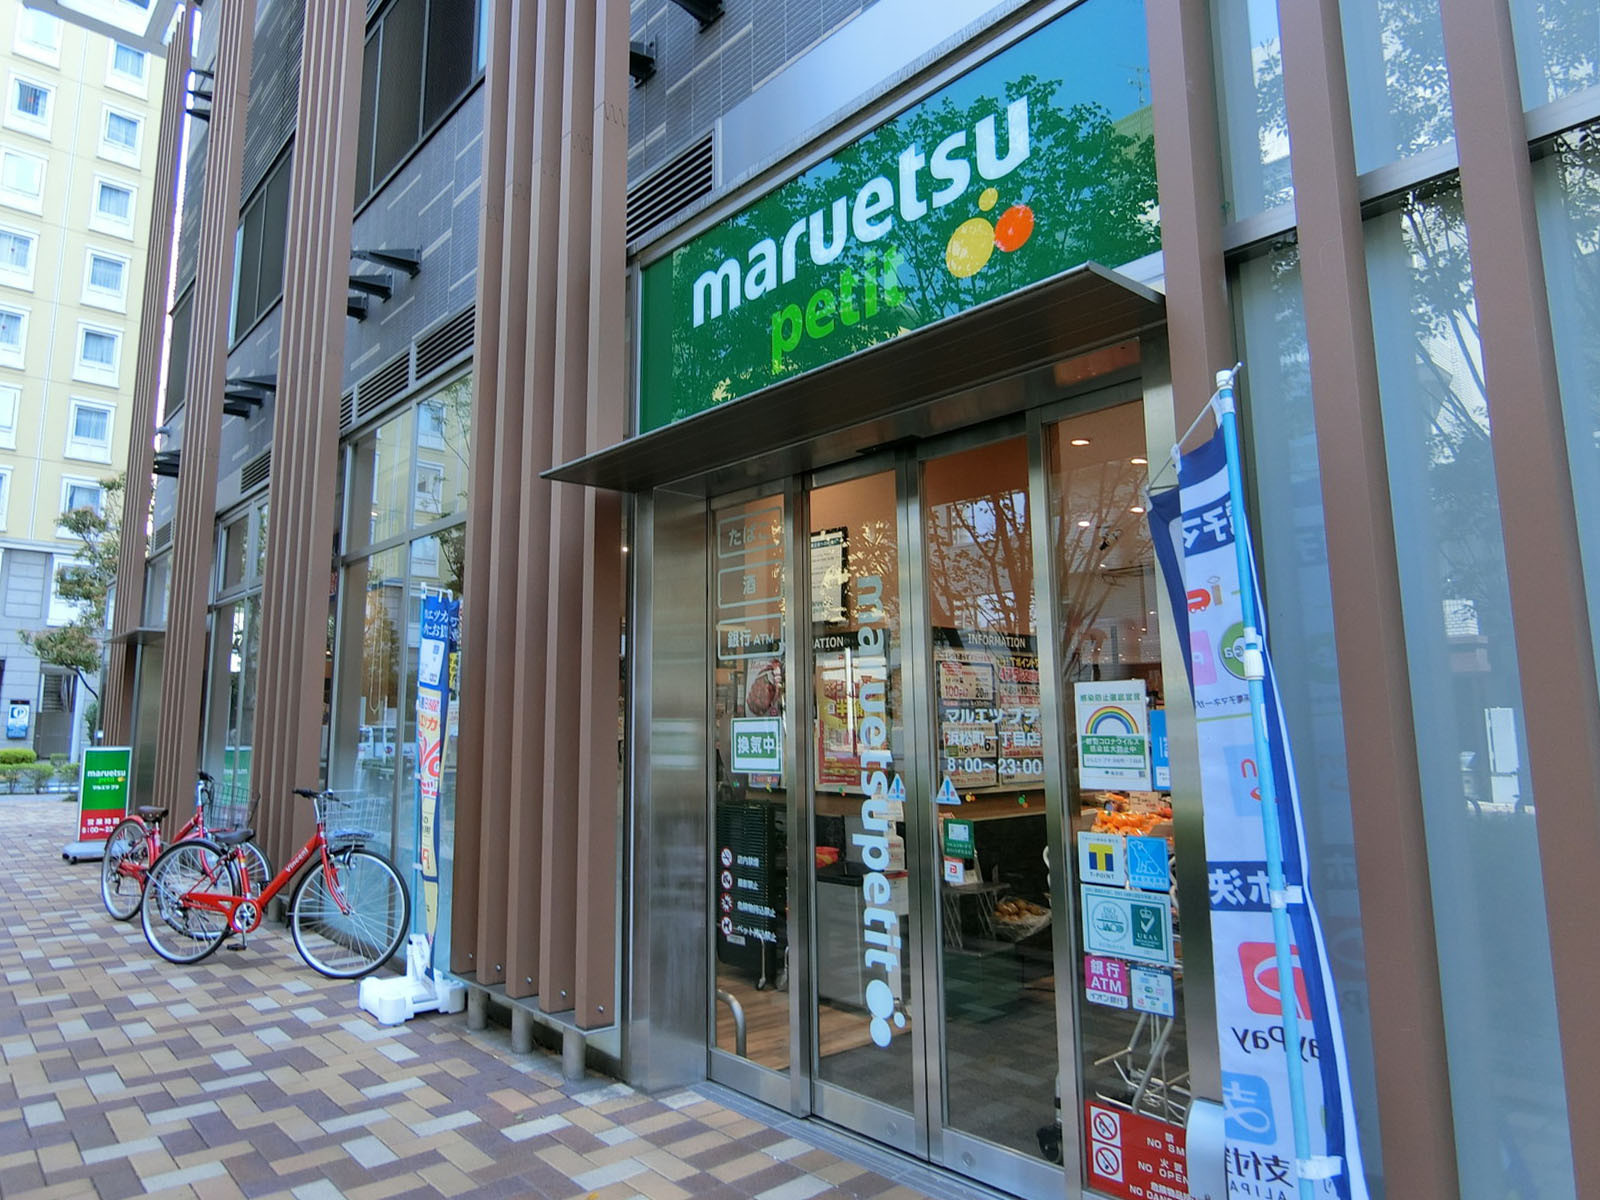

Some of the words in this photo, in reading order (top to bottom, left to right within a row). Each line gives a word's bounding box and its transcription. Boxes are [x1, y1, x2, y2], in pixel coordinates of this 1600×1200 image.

[692, 95, 1031, 327] maruetsu
[771, 246, 906, 375] petit
[729, 522, 768, 546] たばこ
[743, 575, 757, 595] 酒
[728, 629, 751, 648] 銀行
[753, 633, 775, 647] ATM
[968, 633, 1026, 649] INFORMATION
[945, 708, 1004, 724] マルエツ
[737, 734, 775, 755] 換気中
[87, 769, 126, 777] maruetsu
[1090, 958, 1120, 978] 銀行
[1091, 978, 1122, 993] ATM
[1146, 1137, 1162, 1149] NO
[1138, 1160, 1153, 1173] NO
[1129, 1184, 1144, 1197] NO
